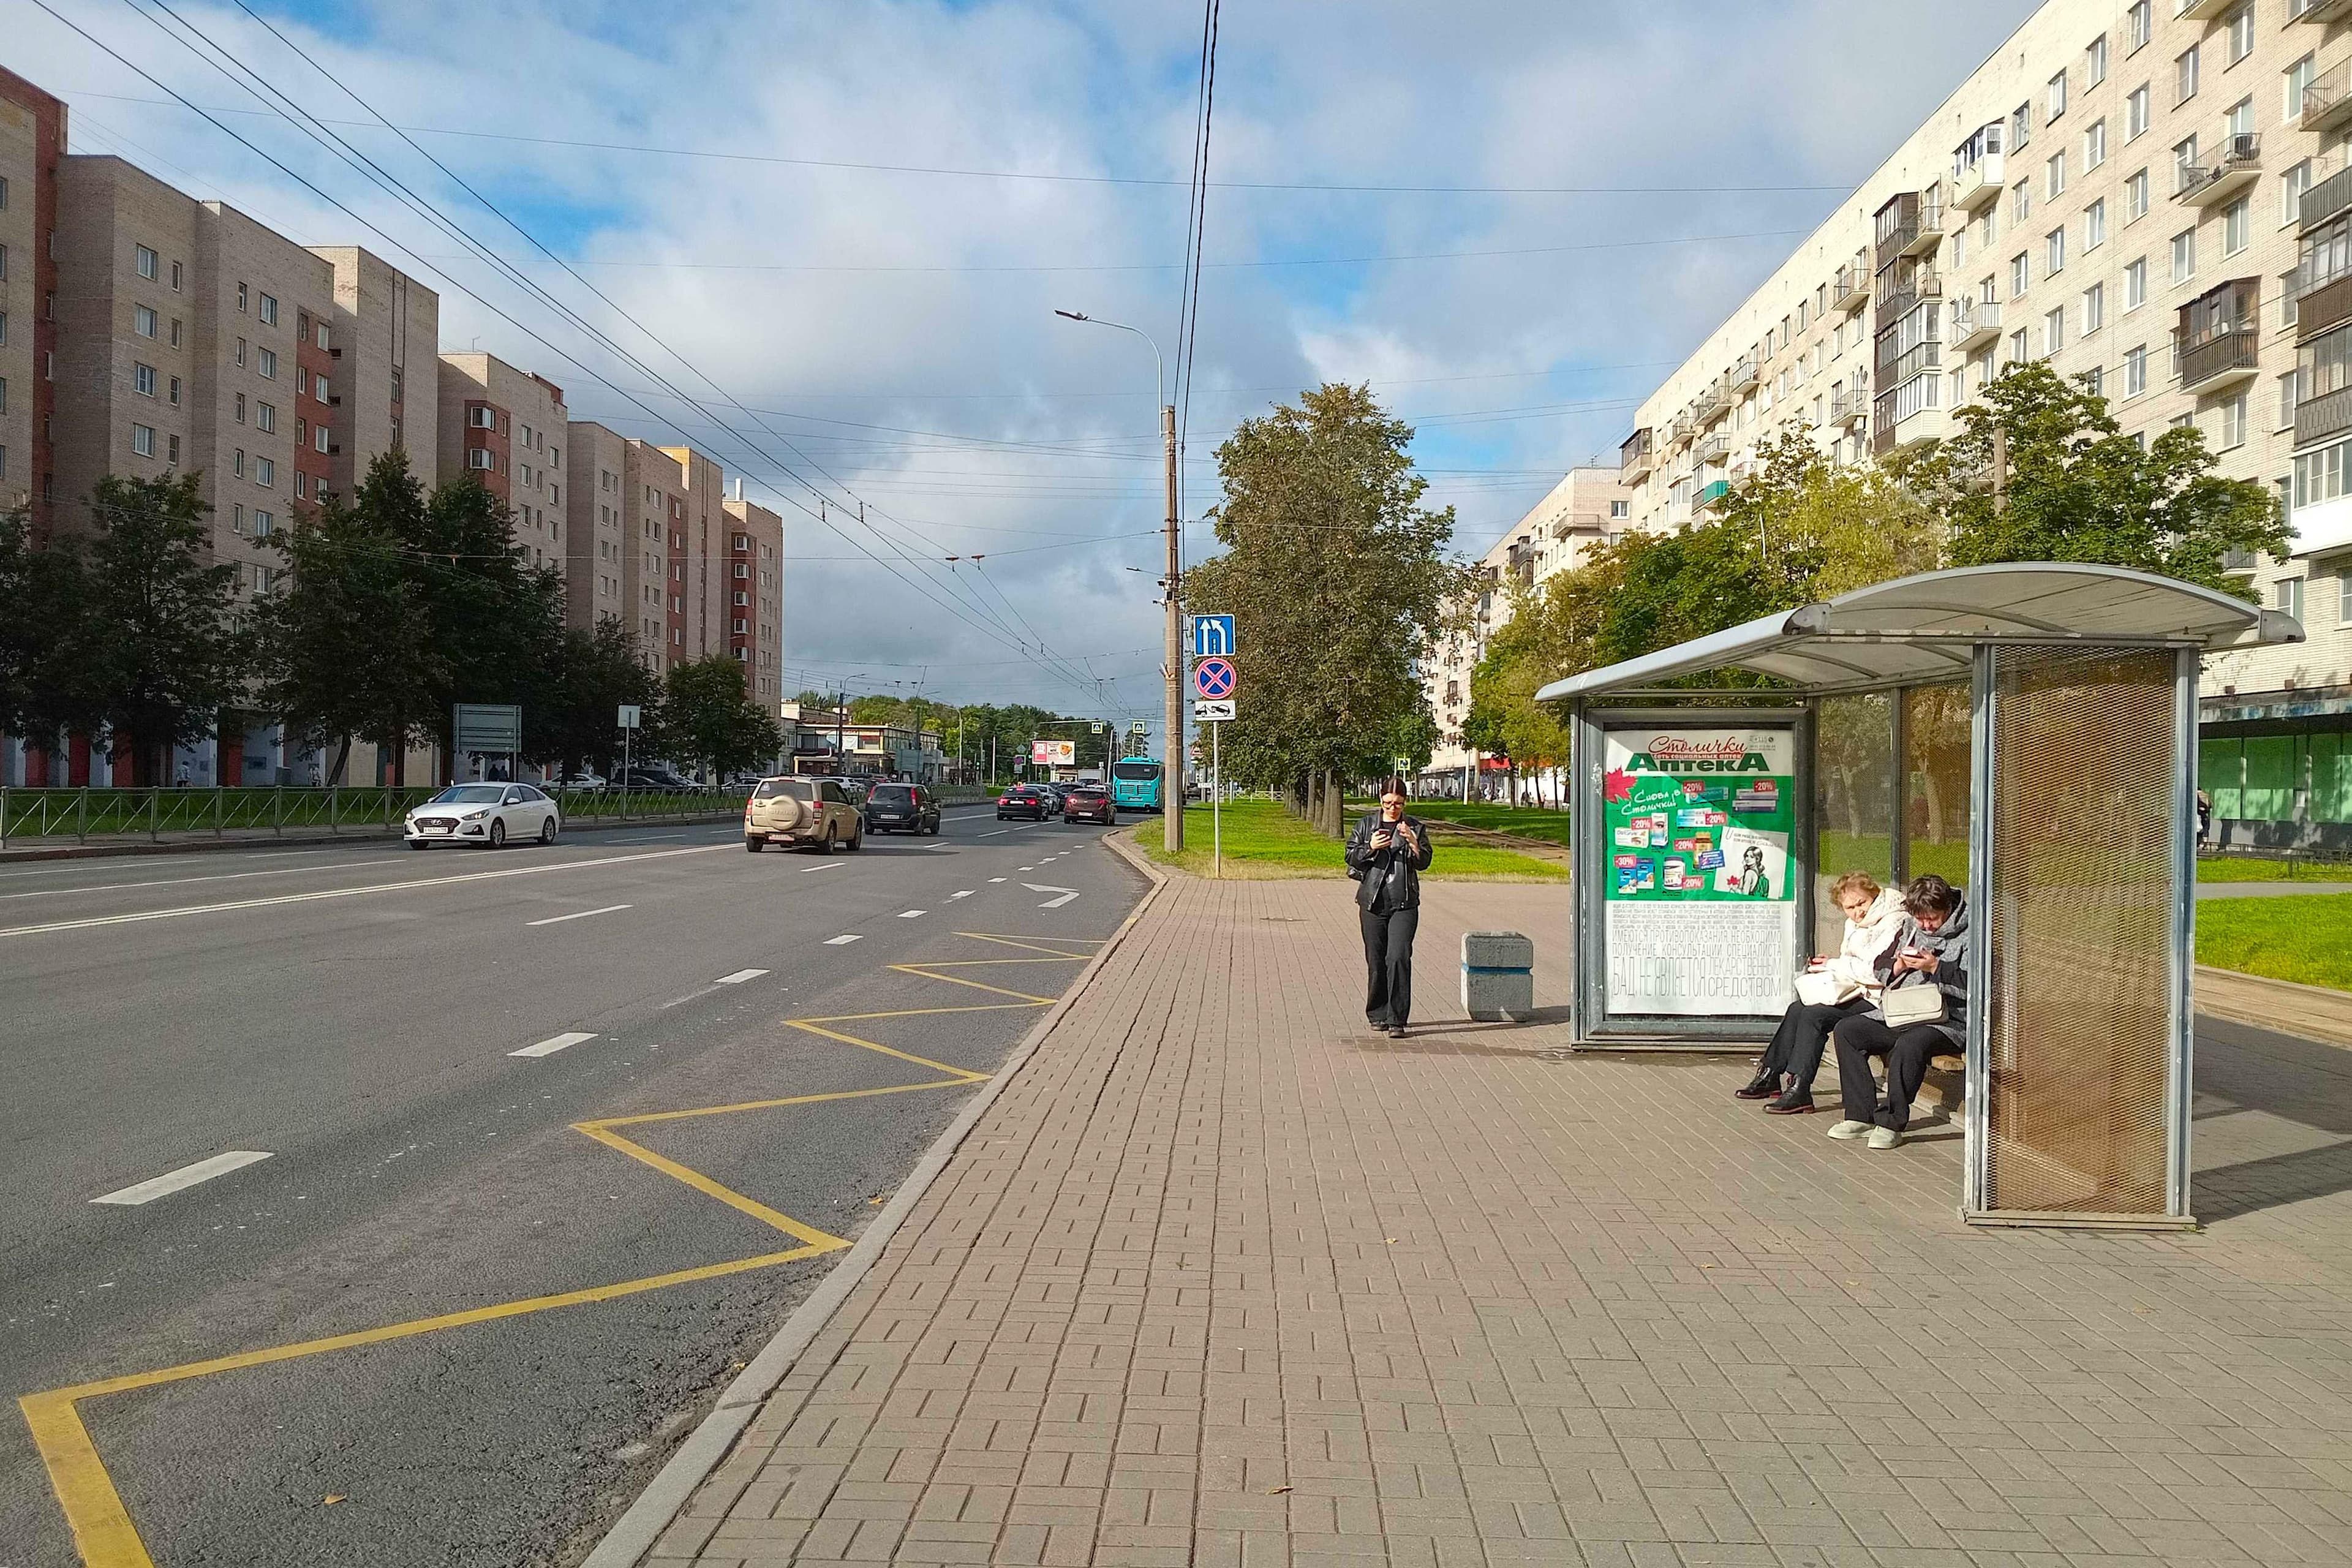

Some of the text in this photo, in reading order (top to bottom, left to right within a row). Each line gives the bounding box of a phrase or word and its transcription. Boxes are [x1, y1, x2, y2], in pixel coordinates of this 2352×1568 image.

[1648, 736, 1747, 753] Столички
[1684, 783, 1702, 792] -20%
[1706, 815, 1725, 823] -20%
[1613, 930, 1648, 942] ИМЕЮТСЯ
[1732, 930, 1782, 943] НЕОБХОДИМО
[1613, 943, 1781, 957] ПОЛУЧЕНИЕ КОНСУЛЬТАЦИИ СПЕЦИАЛИСТА
[1709, 957, 1781, 976] ЛЕКАРСТВЕННЫМ
[1640, 957, 1651, 996] НЕ
[1655, 957, 1706, 997] ЯВЛЯЕТСЯ
[1708, 977, 1781, 998] СРЕДСТВОМ
